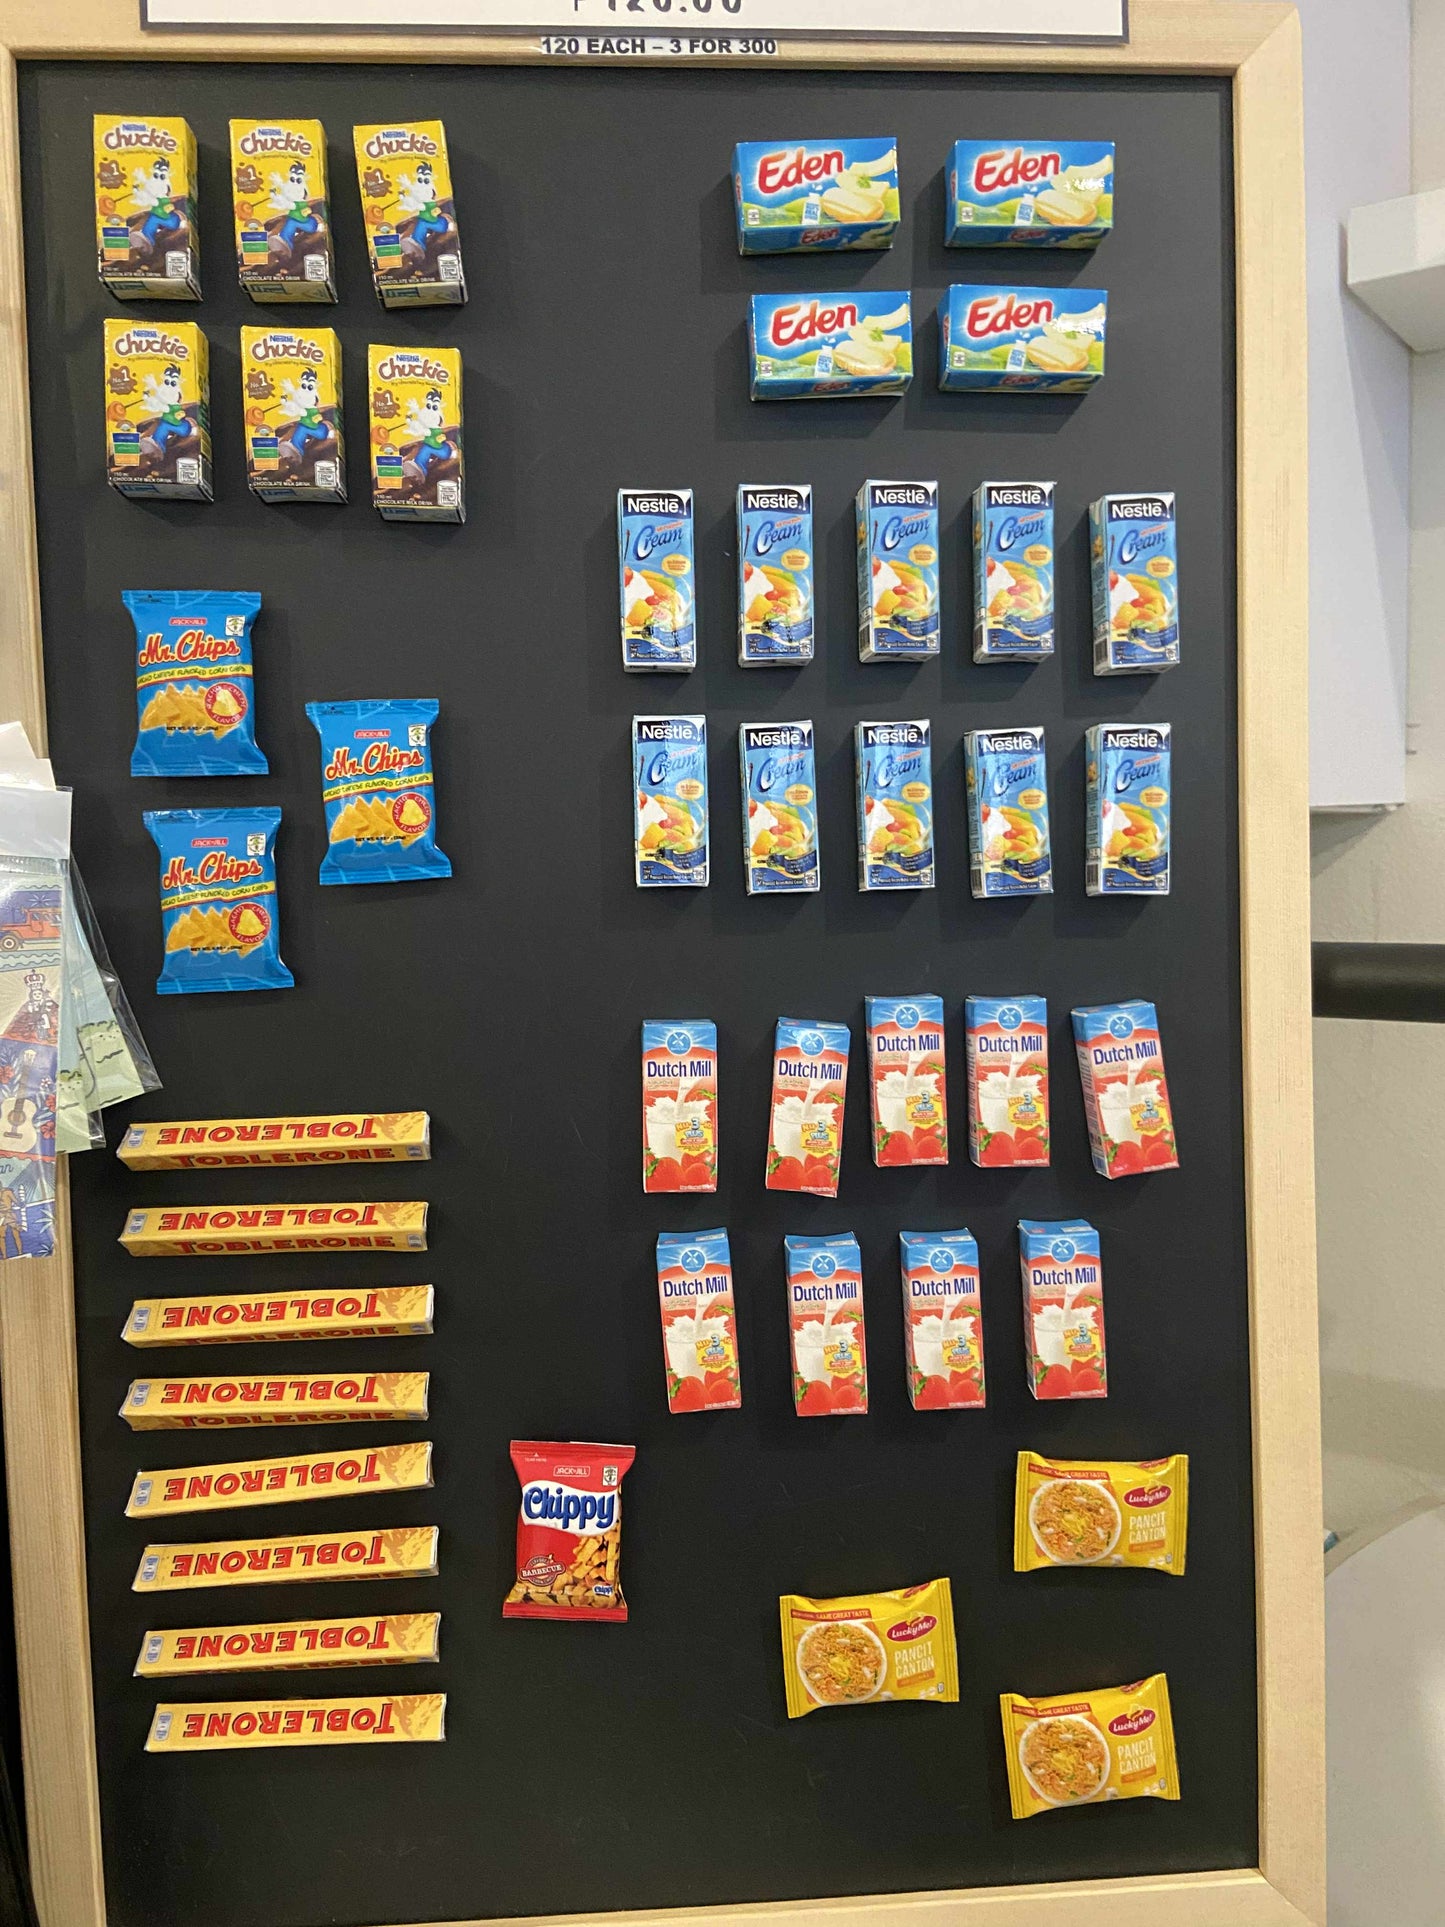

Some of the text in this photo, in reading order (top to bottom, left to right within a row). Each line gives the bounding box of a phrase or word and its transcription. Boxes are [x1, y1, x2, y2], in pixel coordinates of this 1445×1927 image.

[541, 38, 580, 54] 120
[586, 38, 646, 54] EACH
[670, 39, 682, 54] 3
[689, 39, 732, 54] FOR
[739, 39, 777, 54] 300
[104, 127, 177, 152] Chuckie
[240, 132, 312, 155] Chuckie
[366, 133, 437, 158] Chuckie
[758, 147, 844, 194] Eden
[974, 147, 1060, 193] Eden
[801, 229, 840, 244] Eden
[771, 299, 857, 347] Eden
[966, 293, 1053, 339] Eden
[115, 333, 188, 358] Chuckie
[252, 338, 324, 362] Chuckie
[379, 357, 449, 382] Chuckie
[633, 525, 683, 561] Cream
[753, 520, 803, 556] Cream
[881, 514, 931, 551] Cream
[996, 514, 1046, 550] Cream
[1118, 528, 1168, 565] Cream
[139, 630, 240, 666] Mr. Chips
[208, 667, 228, 675] CORN
[212, 713, 241, 724] FLAVOR
[325, 742, 424, 780] Mr. Chips
[647, 750, 697, 786] Cream
[874, 753, 922, 788] Cream
[395, 777, 413, 786] CORN
[756, 756, 807, 793] Cream
[1114, 758, 1161, 794] Cream
[400, 823, 427, 833] FLAVOR
[162, 851, 263, 890] Mr. Chips
[232, 887, 251, 896] CORN
[236, 932, 264, 943] FLAVOR
[877, 1034, 940, 1053] Dutch Mill
[979, 1036, 1042, 1053] Dutch Mill
[1094, 1040, 1158, 1065] Dutch Mill
[647, 1060, 712, 1078] Dutch Mill
[778, 1059, 842, 1080] Dutch Mill
[157, 1118, 378, 1145] TOBLERONE
[170, 1147, 396, 1168] TOBLERONE
[158, 1205, 379, 1231] TOBLERONE
[173, 1235, 396, 1254] TOBLERONE
[663, 1275, 728, 1297] Dutch Mill
[911, 1277, 975, 1297] Dutch Mill
[1033, 1266, 1097, 1286] Dutch Mill
[793, 1282, 857, 1302] Dutch Mill
[161, 1293, 381, 1328] TOBLERONE
[161, 1376, 378, 1404] TOBLERONE
[163, 1453, 381, 1501] TOBLERONE
[523, 1486, 615, 1530] Chippy
[1130, 1511, 1166, 1530] PANCIT
[1129, 1527, 1166, 1543] CANTON
[170, 1536, 386, 1577] TOBLERONE
[522, 1564, 562, 1577] BARBECUE
[174, 1621, 390, 1659] TOBLERONE
[895, 1641, 933, 1664] PANCIT
[895, 1655, 935, 1679] CANTON
[183, 1703, 395, 1738] TOBLERONE
[1117, 1736, 1154, 1757] PANCIT
[1119, 1753, 1156, 1774] CANTON
